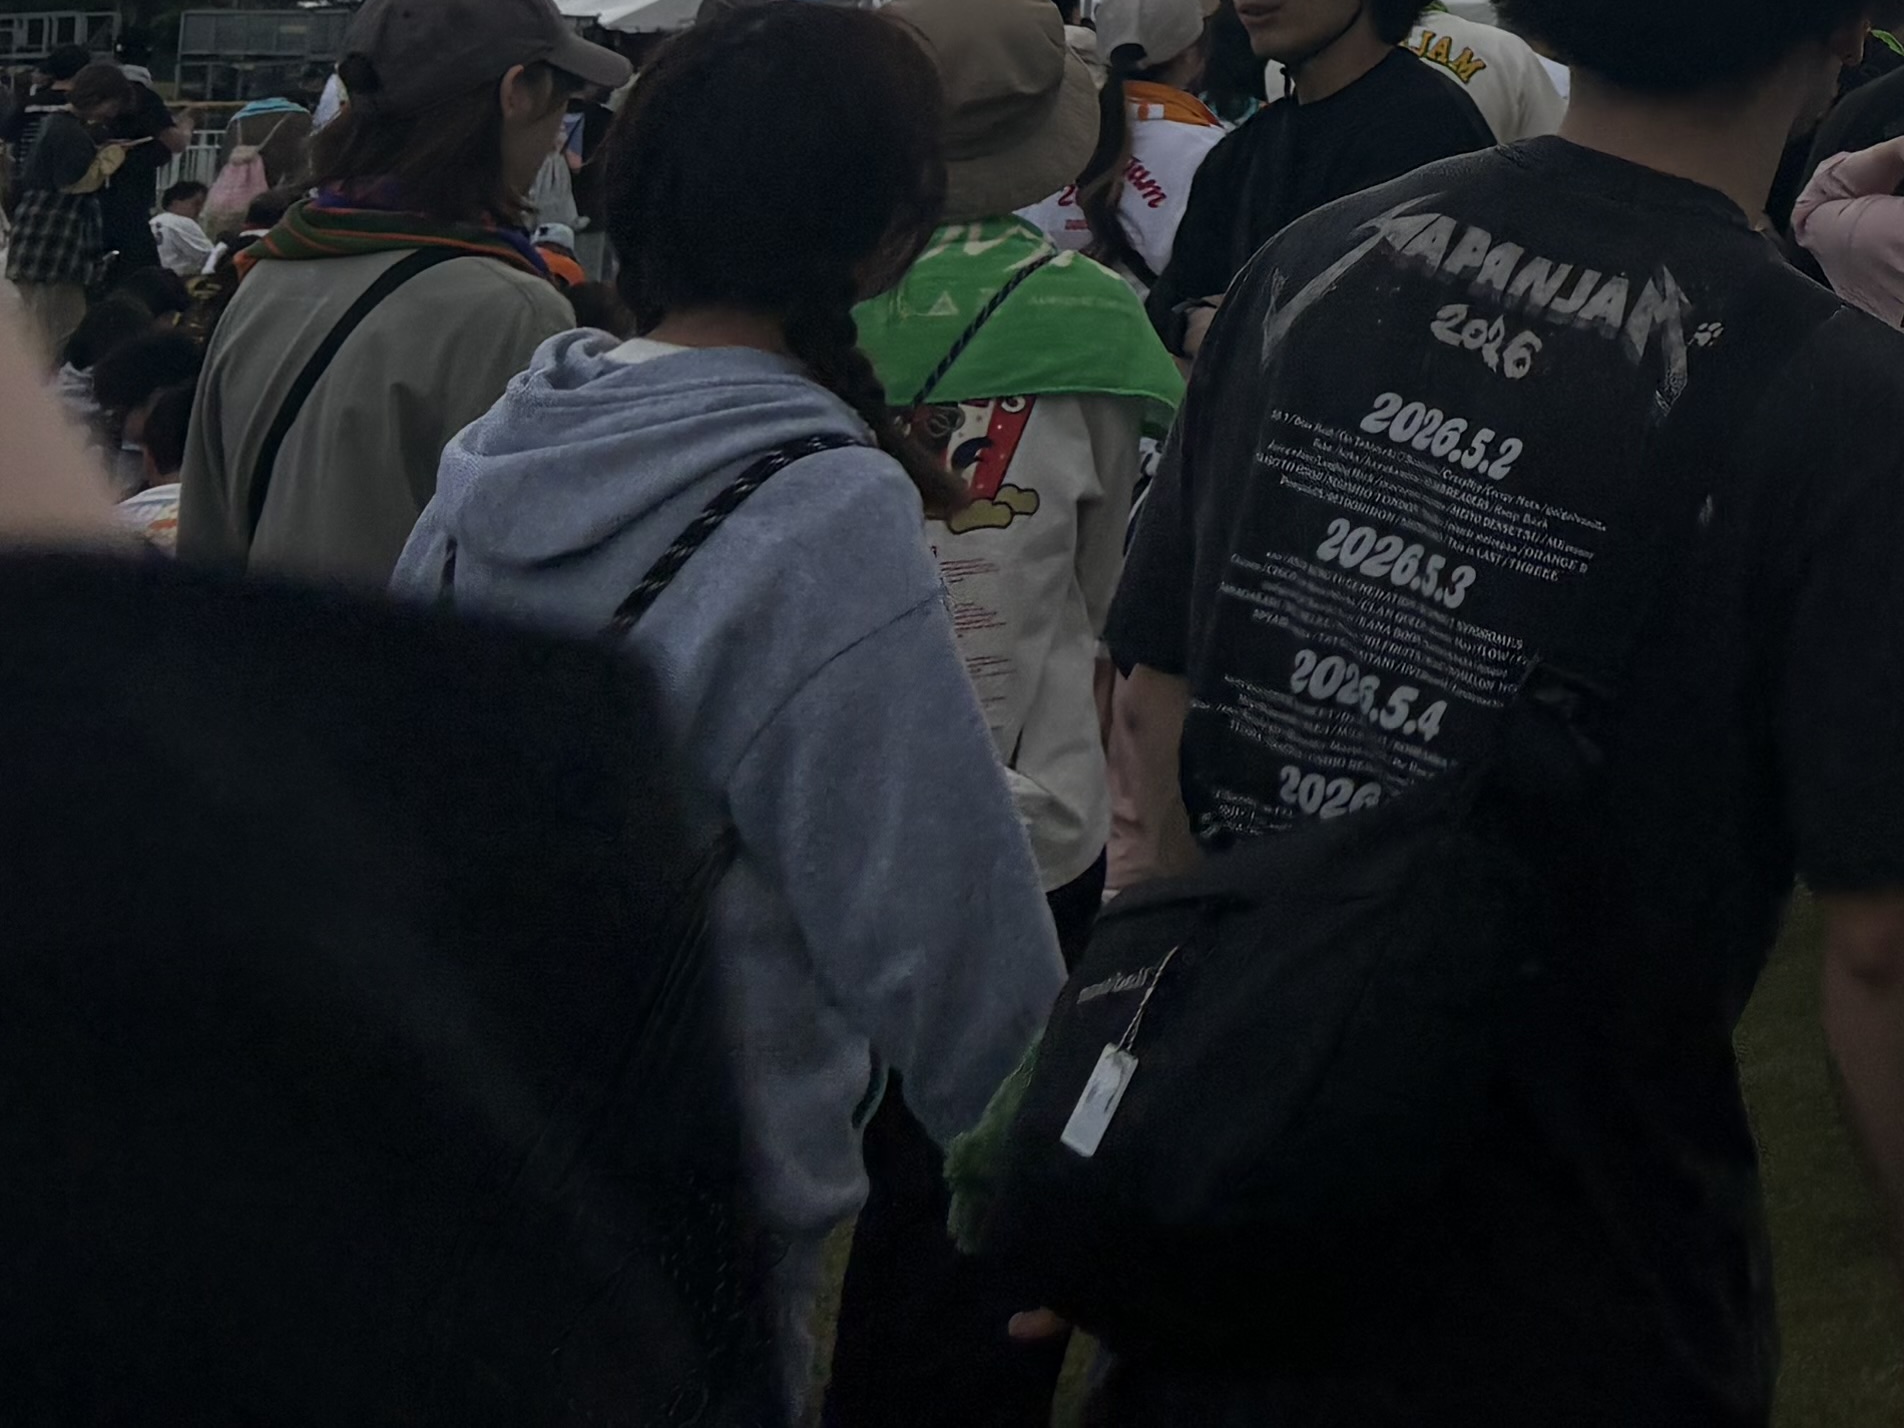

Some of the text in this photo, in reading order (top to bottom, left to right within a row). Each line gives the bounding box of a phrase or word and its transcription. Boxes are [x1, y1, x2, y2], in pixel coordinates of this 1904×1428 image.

[1414, 30, 1487, 84] JAM
[1430, 304, 1543, 380] 2026
[1359, 392, 1524, 480] 2026.5.2
[1316, 517, 1477, 609] 2026.5.3
[1290, 649, 1449, 743] 2026.5.4
